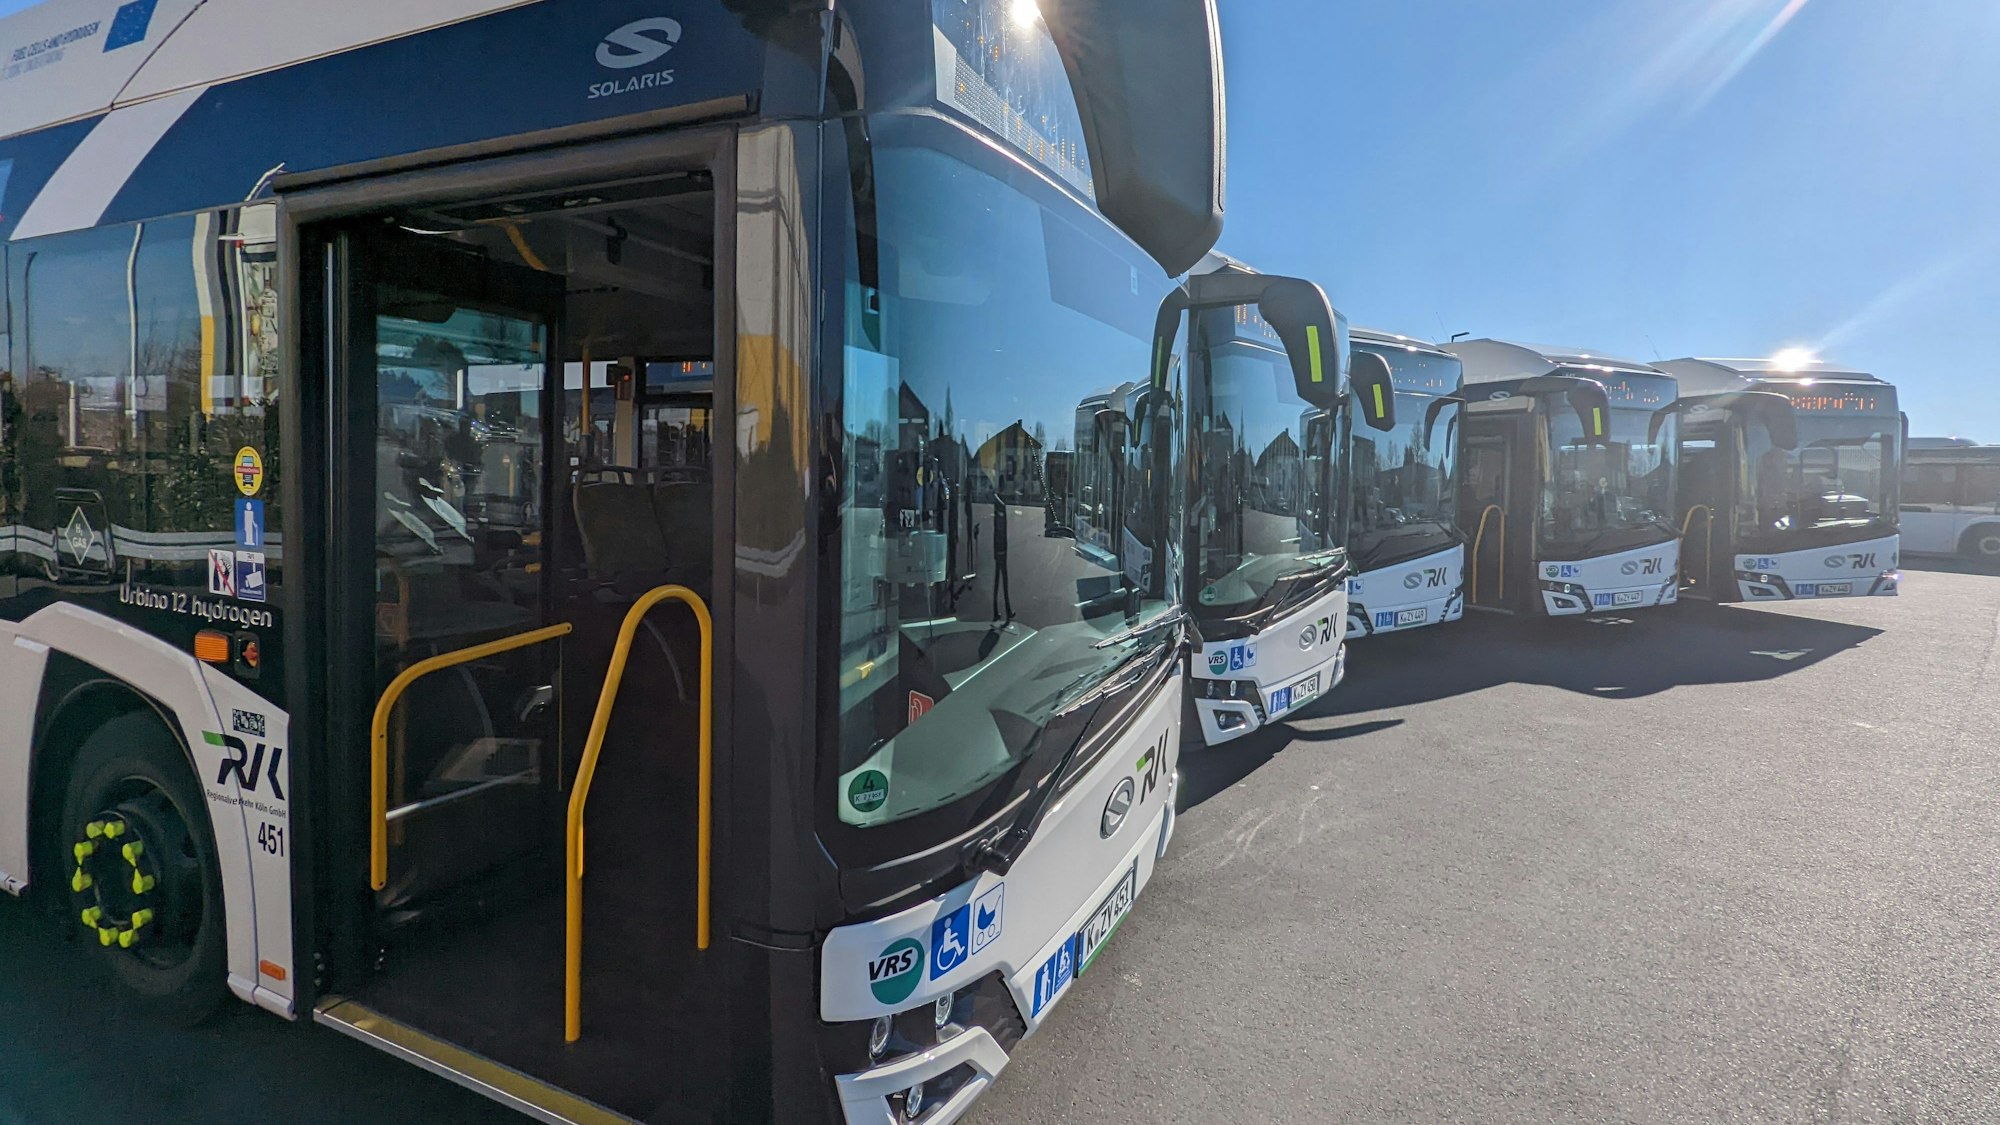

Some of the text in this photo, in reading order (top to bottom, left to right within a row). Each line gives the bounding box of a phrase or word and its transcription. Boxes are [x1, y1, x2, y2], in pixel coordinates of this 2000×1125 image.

[587, 69, 675, 99] SOLARIS
[120, 584, 168, 610] Urbino
[172, 592, 187, 613] 12
[191, 594, 272, 629] hydrogen
[1208, 655, 1224, 665] VRS
[863, 771, 875, 792] 4
[269, 805, 287, 819] GmbH
[258, 821, 284, 858] 451
[868, 948, 914, 982] VRS
